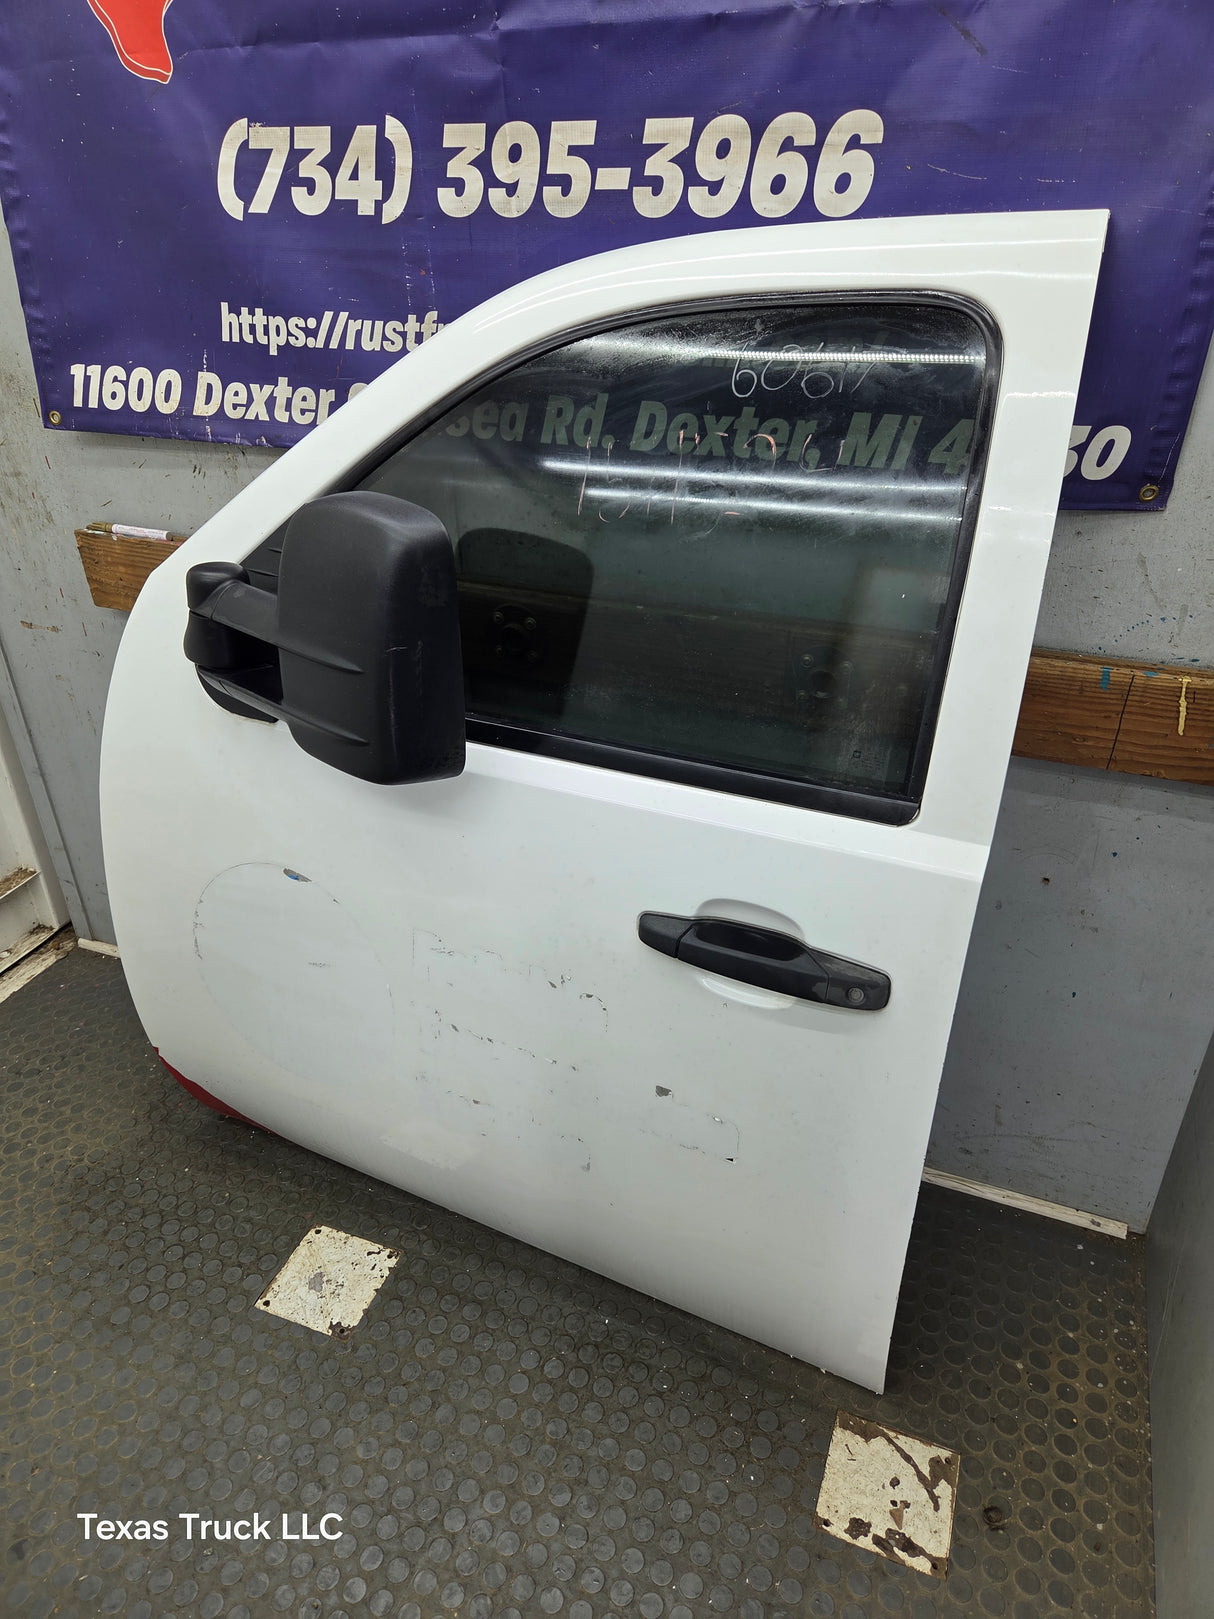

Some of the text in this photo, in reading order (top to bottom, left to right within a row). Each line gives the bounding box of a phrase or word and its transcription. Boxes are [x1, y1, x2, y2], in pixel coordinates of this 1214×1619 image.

[217, 109, 884, 224] (734) 395-3966
[70, 363, 182, 414] 11600
[192, 371, 335, 425] Dexter
[540, 393, 615, 448] Rd.
[630, 400, 821, 471] Dexter,
[837, 411, 923, 471] MI
